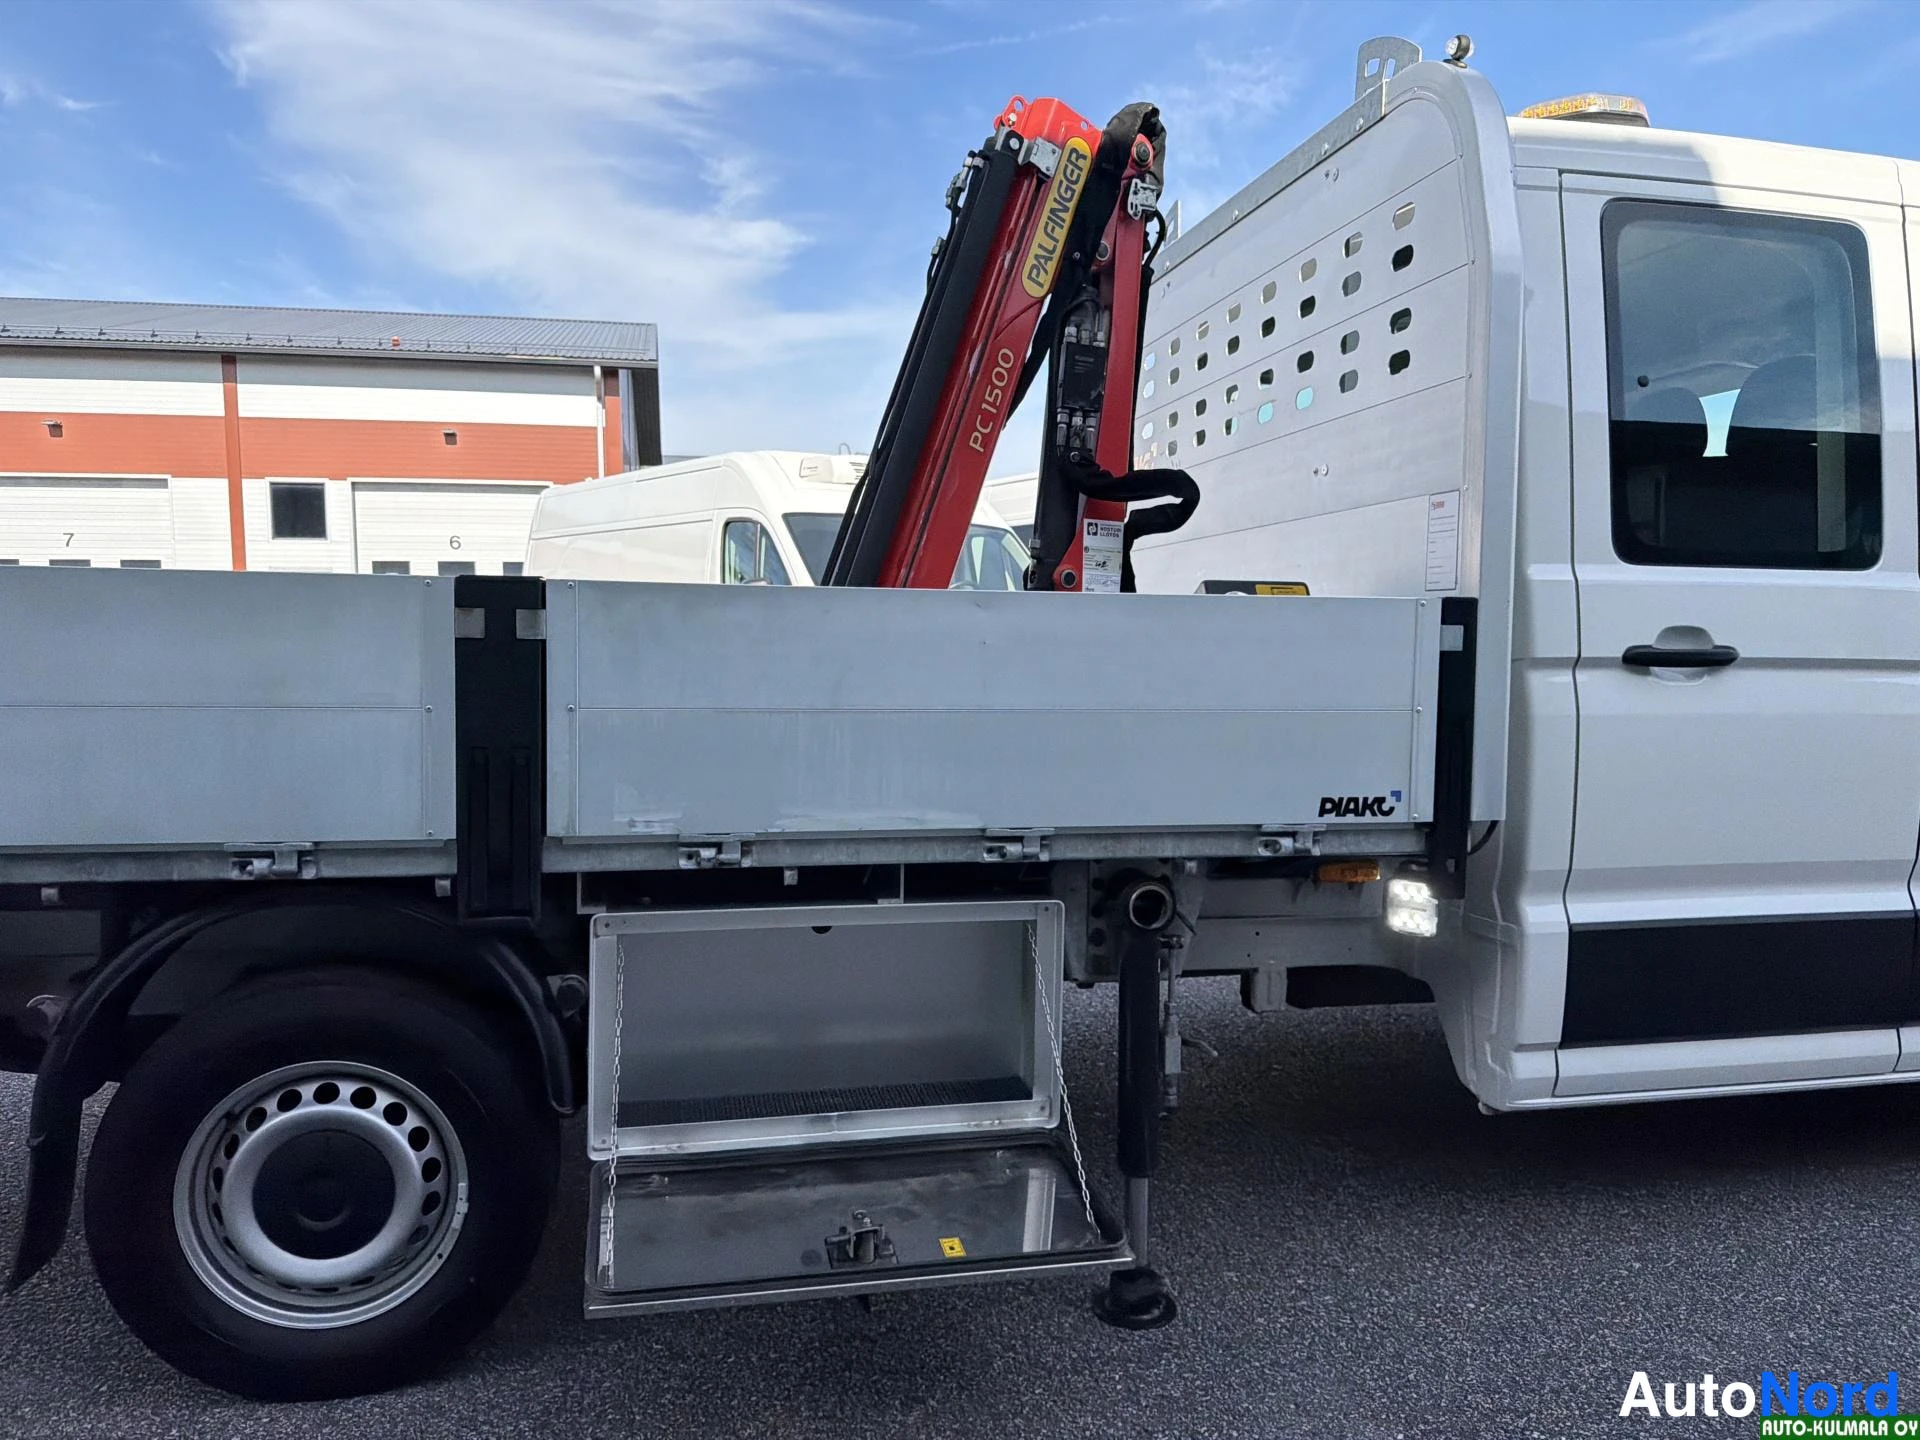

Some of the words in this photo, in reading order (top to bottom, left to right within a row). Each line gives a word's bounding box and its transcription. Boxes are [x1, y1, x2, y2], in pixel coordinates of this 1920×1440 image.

[1027, 147, 1088, 288] PALFINGER
[981, 348, 1014, 414] 1500
[62, 532, 74, 547] 7
[449, 535, 461, 550] 6
